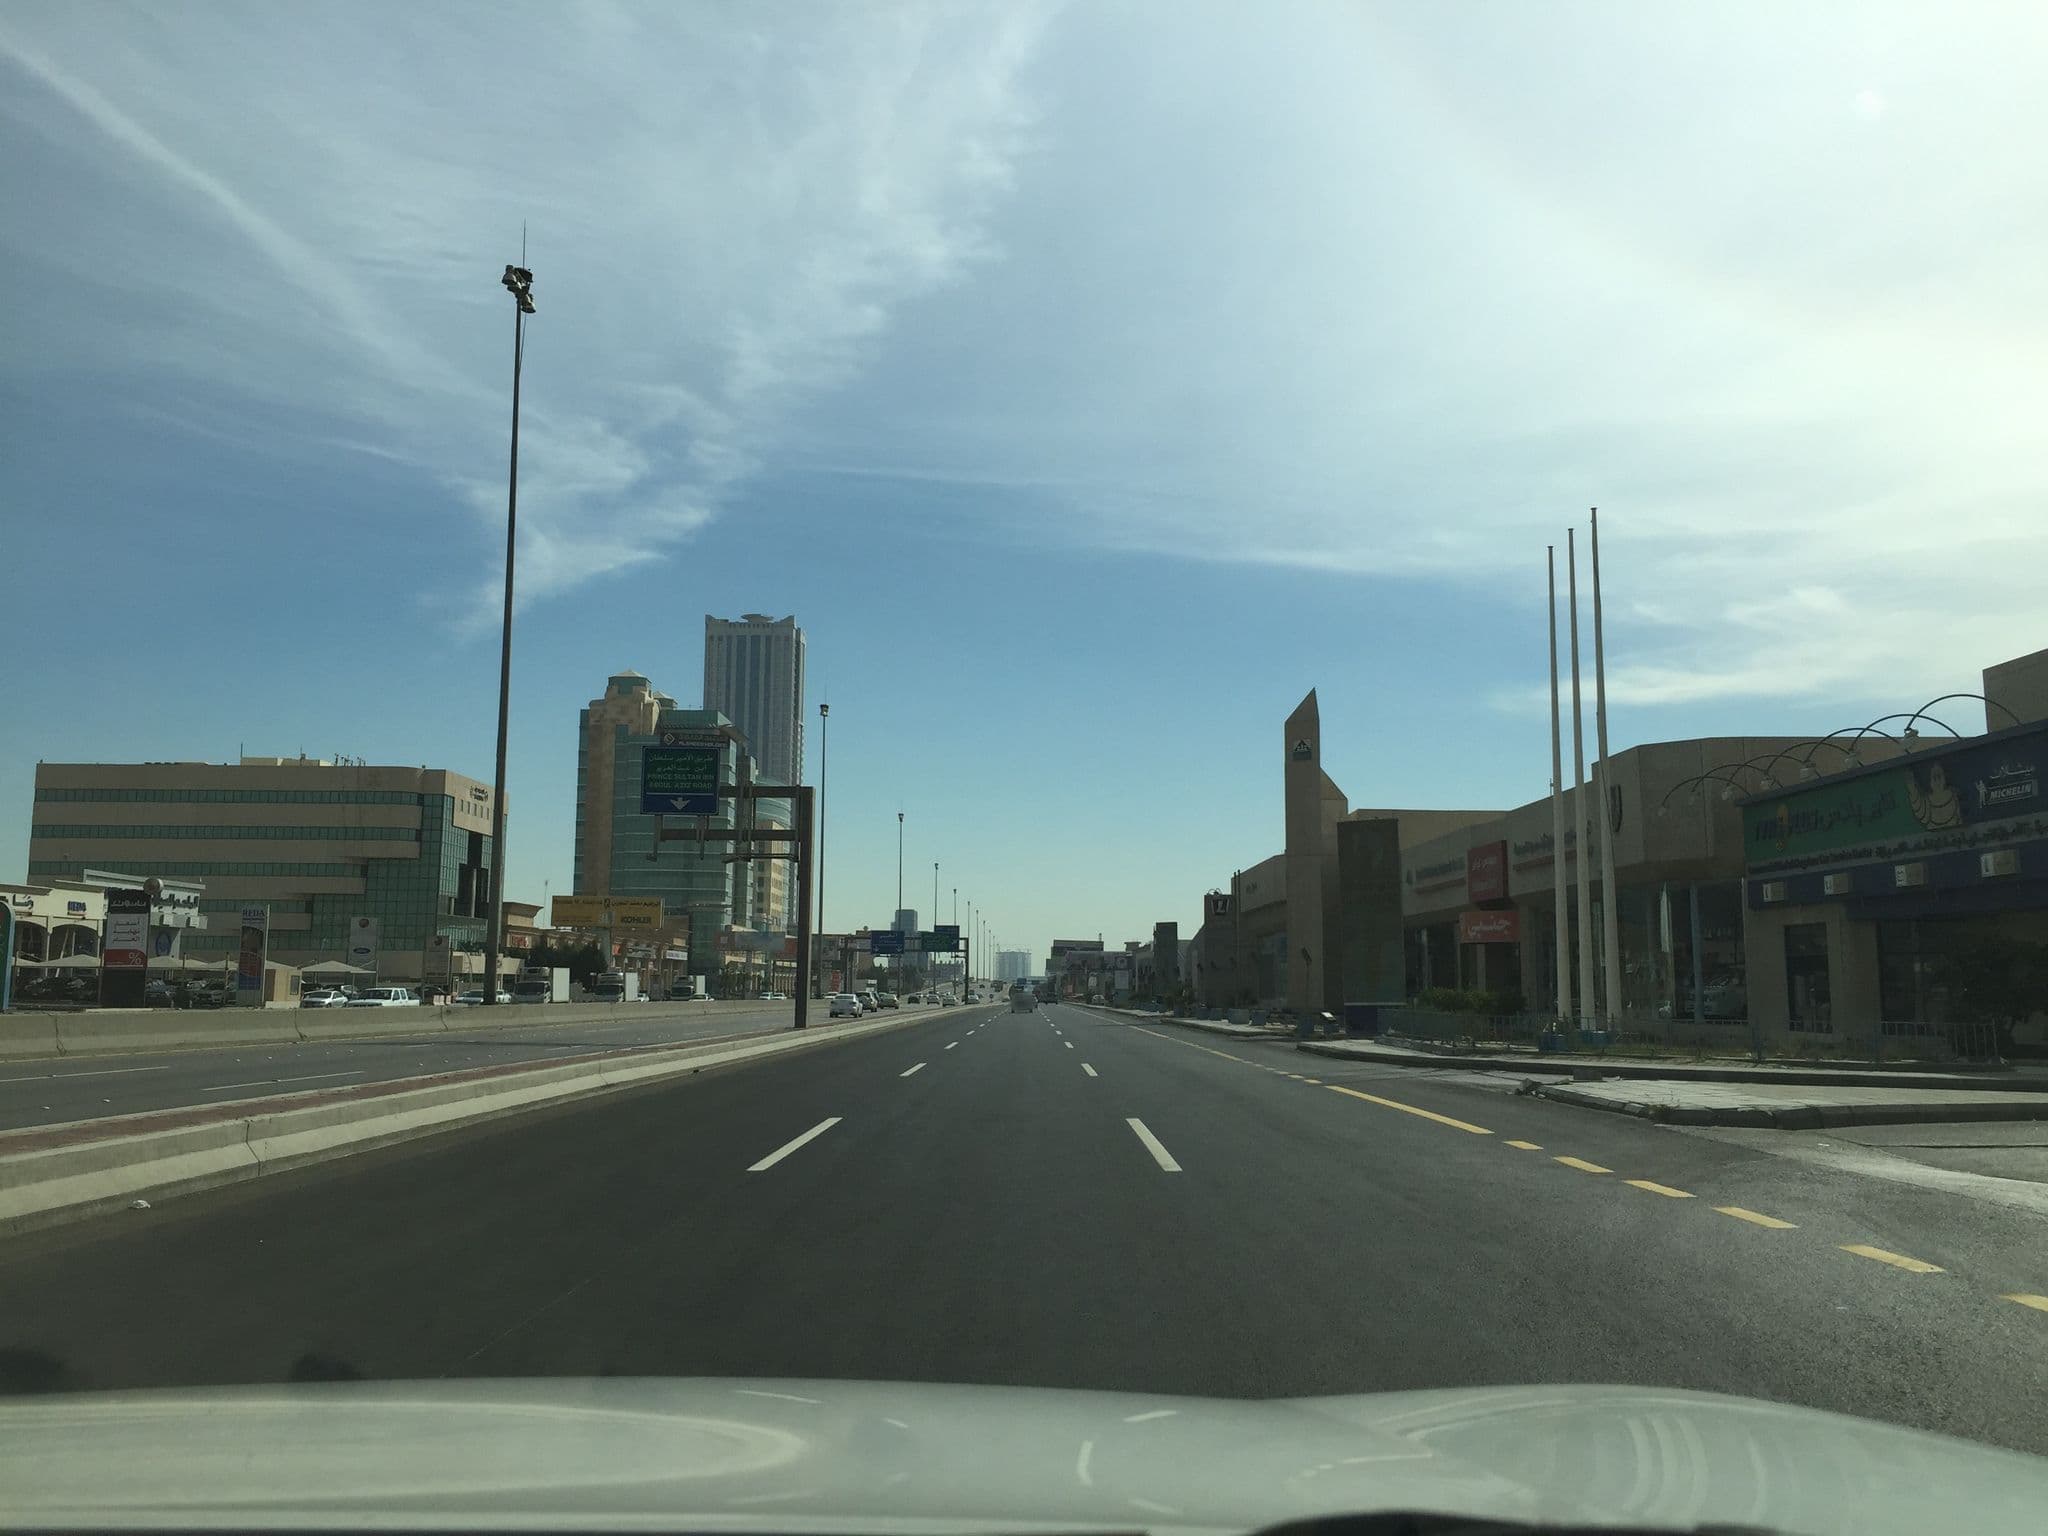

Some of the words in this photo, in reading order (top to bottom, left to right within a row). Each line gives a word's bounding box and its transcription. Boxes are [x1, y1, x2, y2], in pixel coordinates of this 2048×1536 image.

[1989, 783, 2033, 801] MICHELIN
[242, 909, 265, 918] REDA
[621, 916, 651, 924] KOHLER
